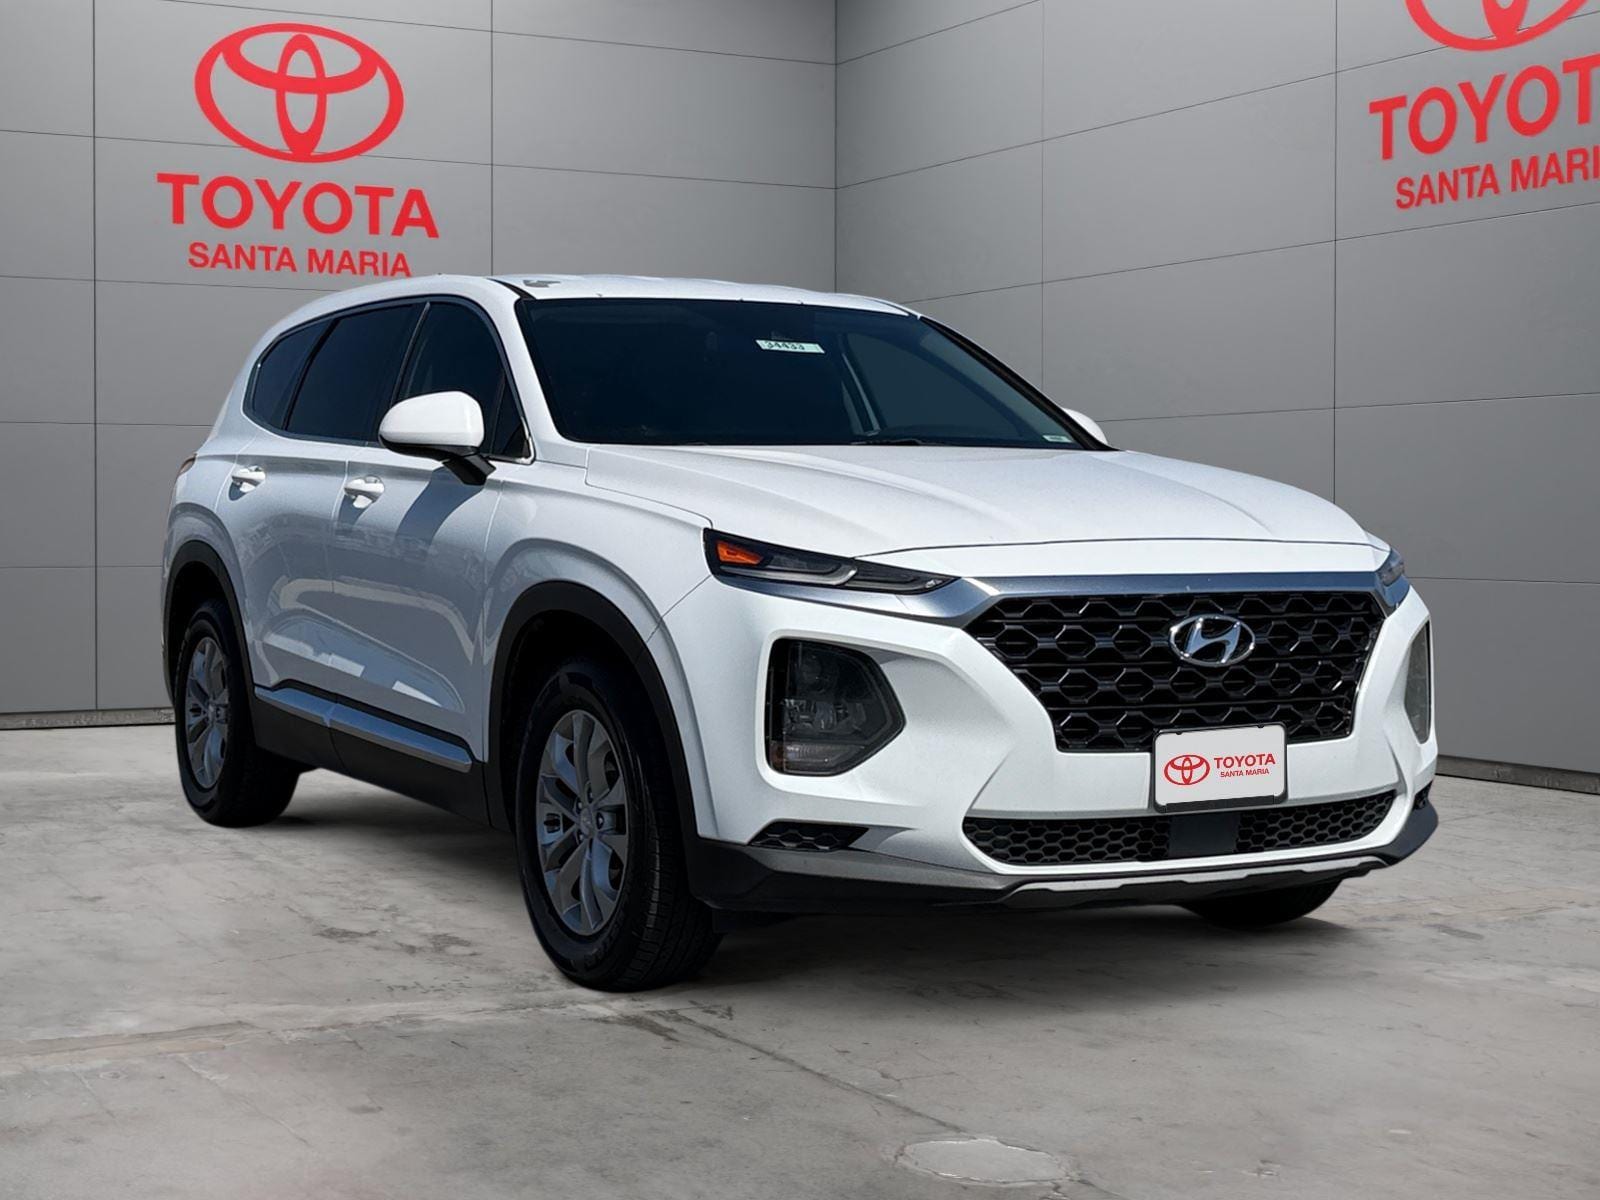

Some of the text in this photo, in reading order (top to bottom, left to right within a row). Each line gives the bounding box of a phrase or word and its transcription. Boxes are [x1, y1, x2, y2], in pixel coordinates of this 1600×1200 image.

[1369, 52, 1600, 160] TOYOT
[1395, 145, 1600, 210] SANTA MARI
[156, 172, 440, 239] TOYOTA
[188, 241, 412, 278] SANTA MARIA
[1213, 753, 1276, 769] TOYOTA
[1220, 768, 1270, 778] SANTA MARIA
